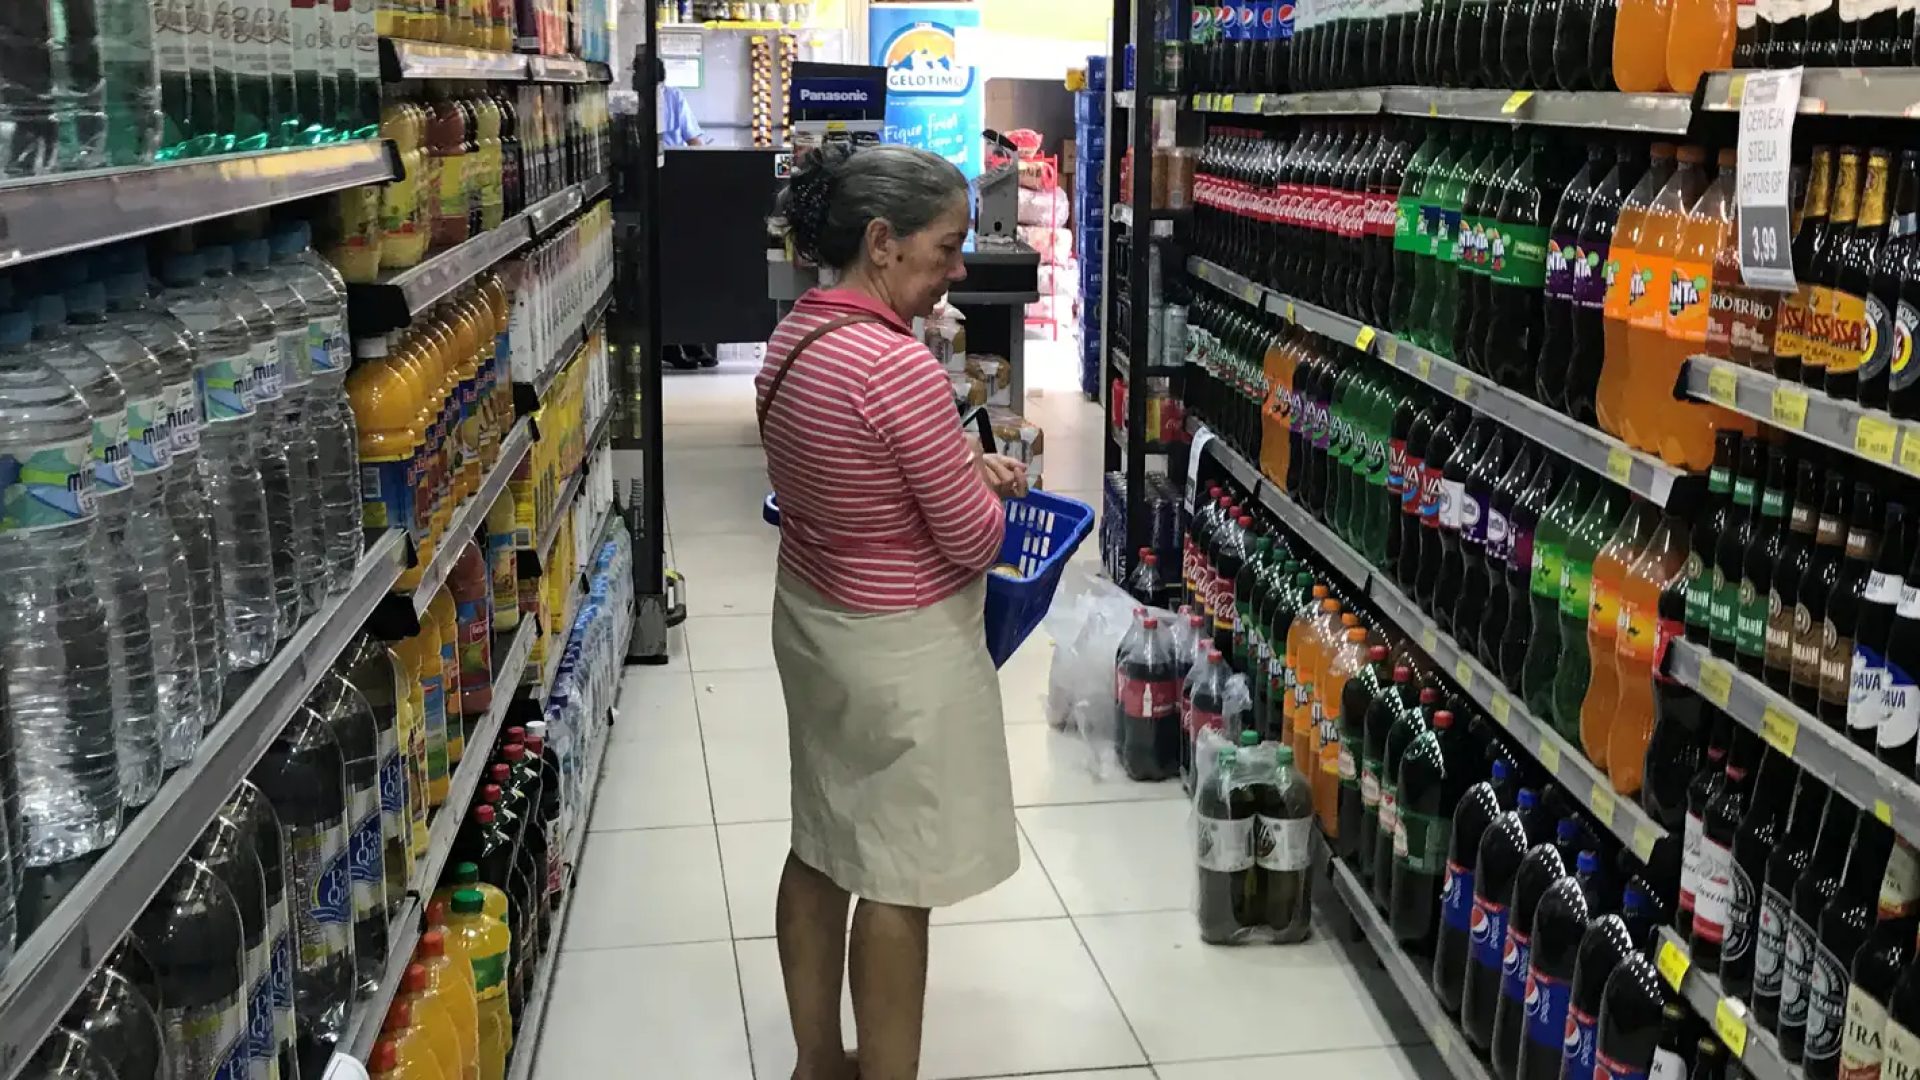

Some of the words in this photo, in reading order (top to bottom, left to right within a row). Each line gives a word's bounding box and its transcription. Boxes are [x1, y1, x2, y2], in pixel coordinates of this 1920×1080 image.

[800, 88, 868, 101] Panasonic
[1748, 140, 1776, 162] STELLA
[1752, 226, 1777, 265] 3,99
